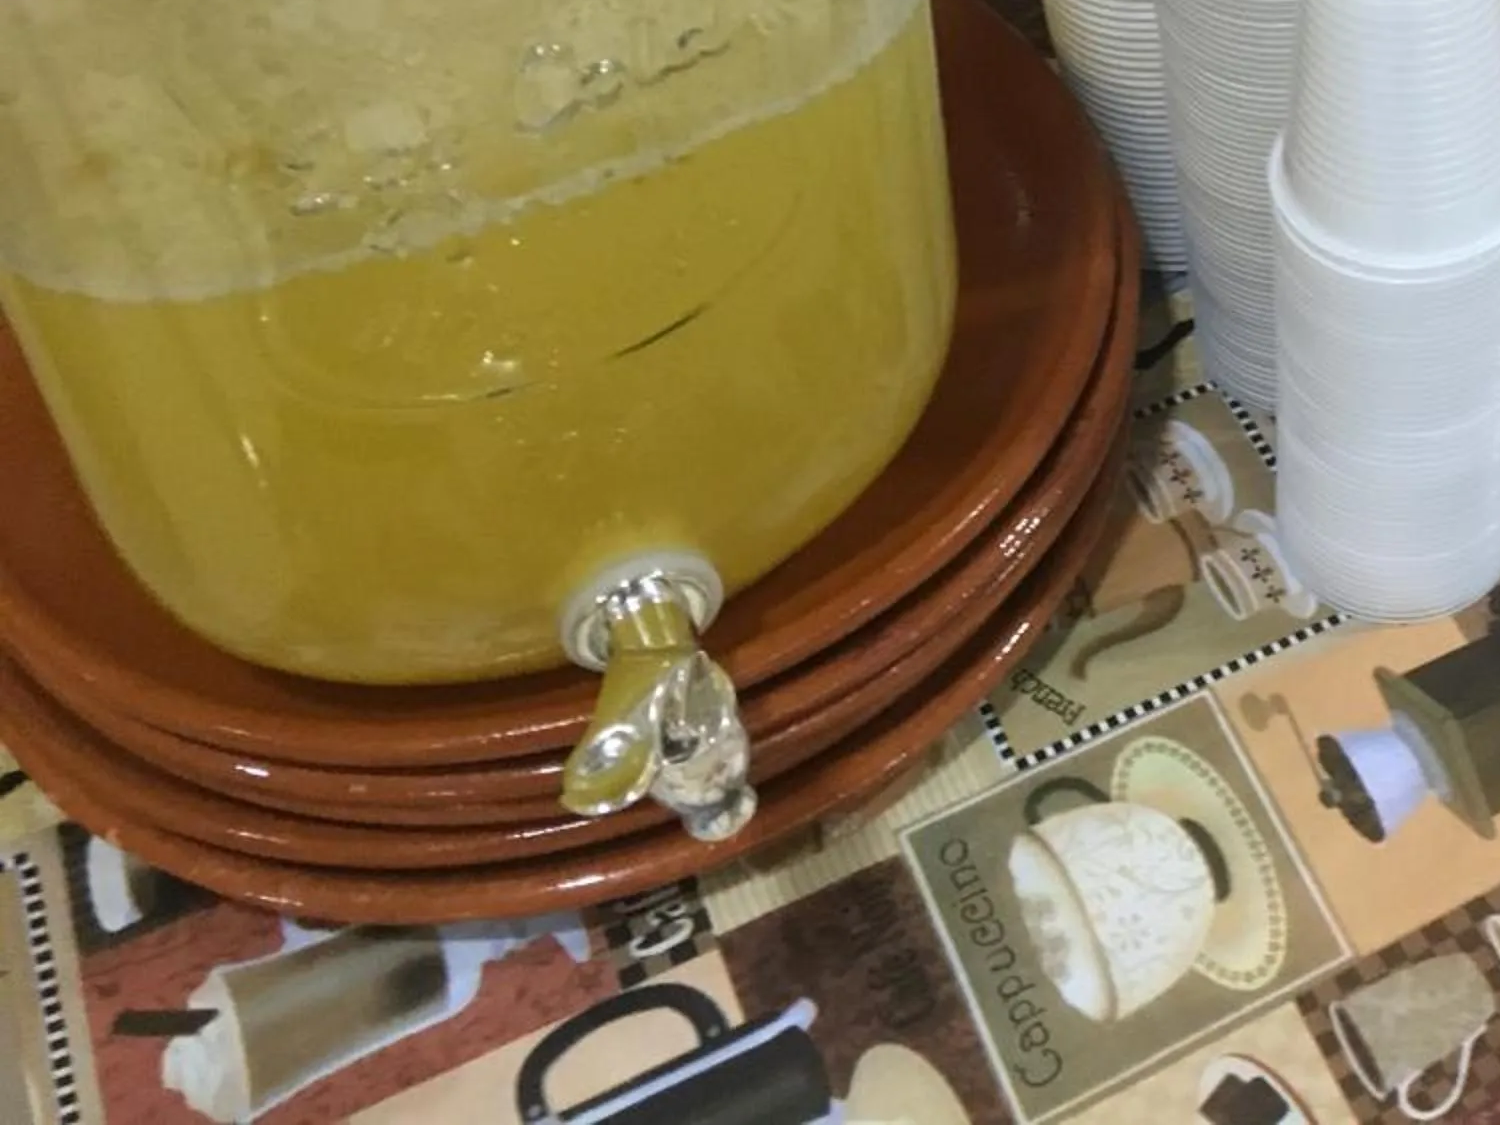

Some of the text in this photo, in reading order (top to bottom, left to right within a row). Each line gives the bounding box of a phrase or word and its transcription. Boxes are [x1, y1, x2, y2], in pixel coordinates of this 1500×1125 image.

[1009, 667, 1087, 727] French
[612, 884, 695, 958] Caf
[939, 836, 1064, 1089] Cappuccino
